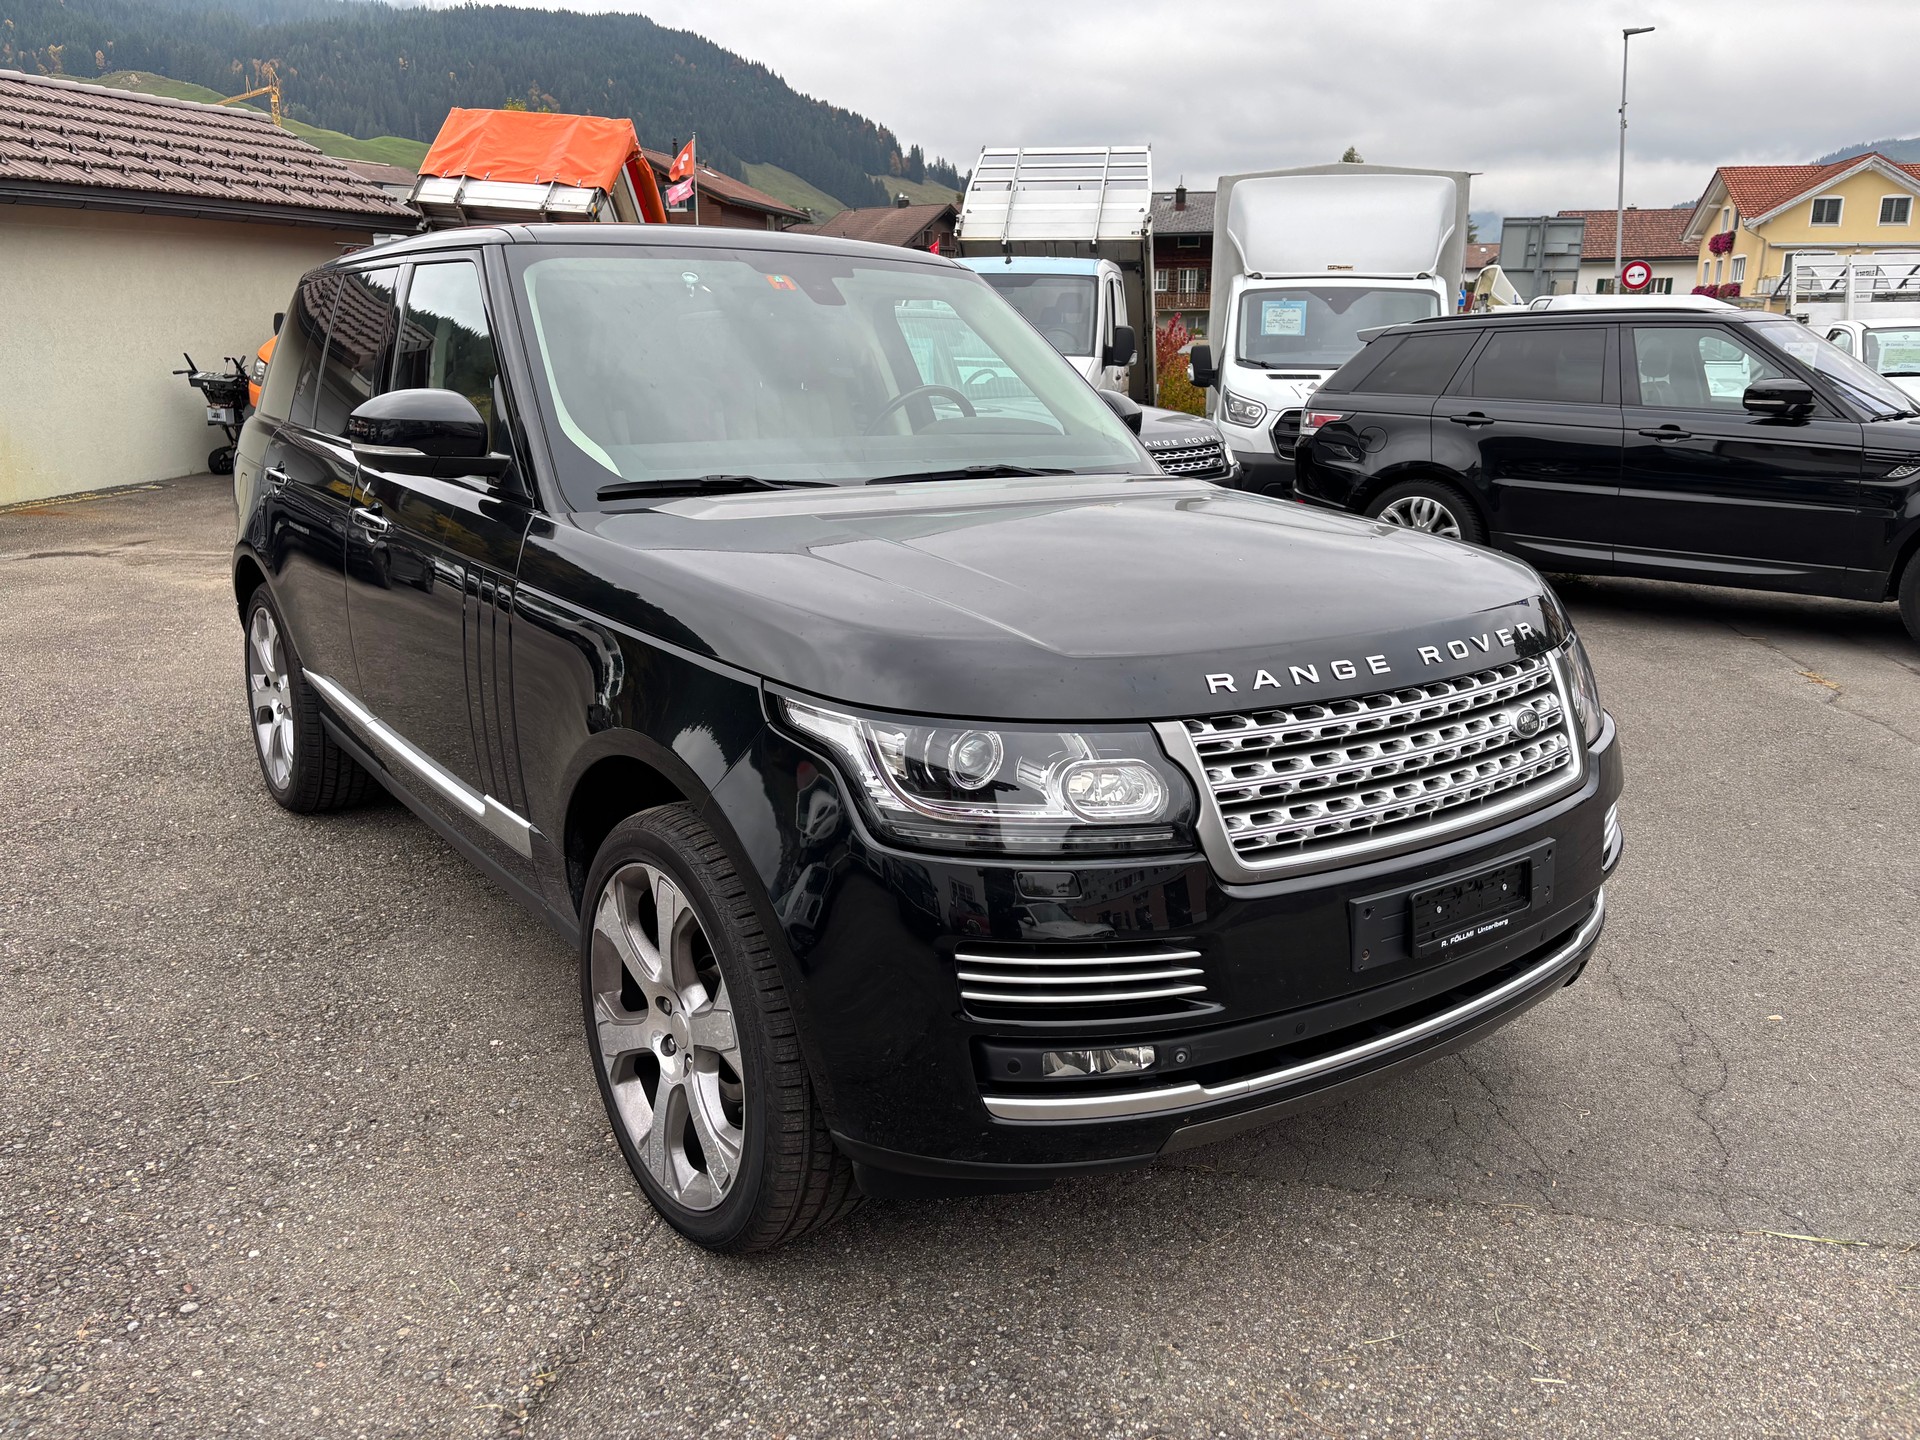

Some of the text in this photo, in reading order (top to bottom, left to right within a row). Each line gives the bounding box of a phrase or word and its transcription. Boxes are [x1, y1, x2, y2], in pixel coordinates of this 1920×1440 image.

[1184, 435, 1217, 444] ROVER
[1205, 622, 1536, 695] RANGE ROVER
[1450, 930, 1475, 944] FÖLLMI
[1477, 919, 1509, 934] Unteriberg
